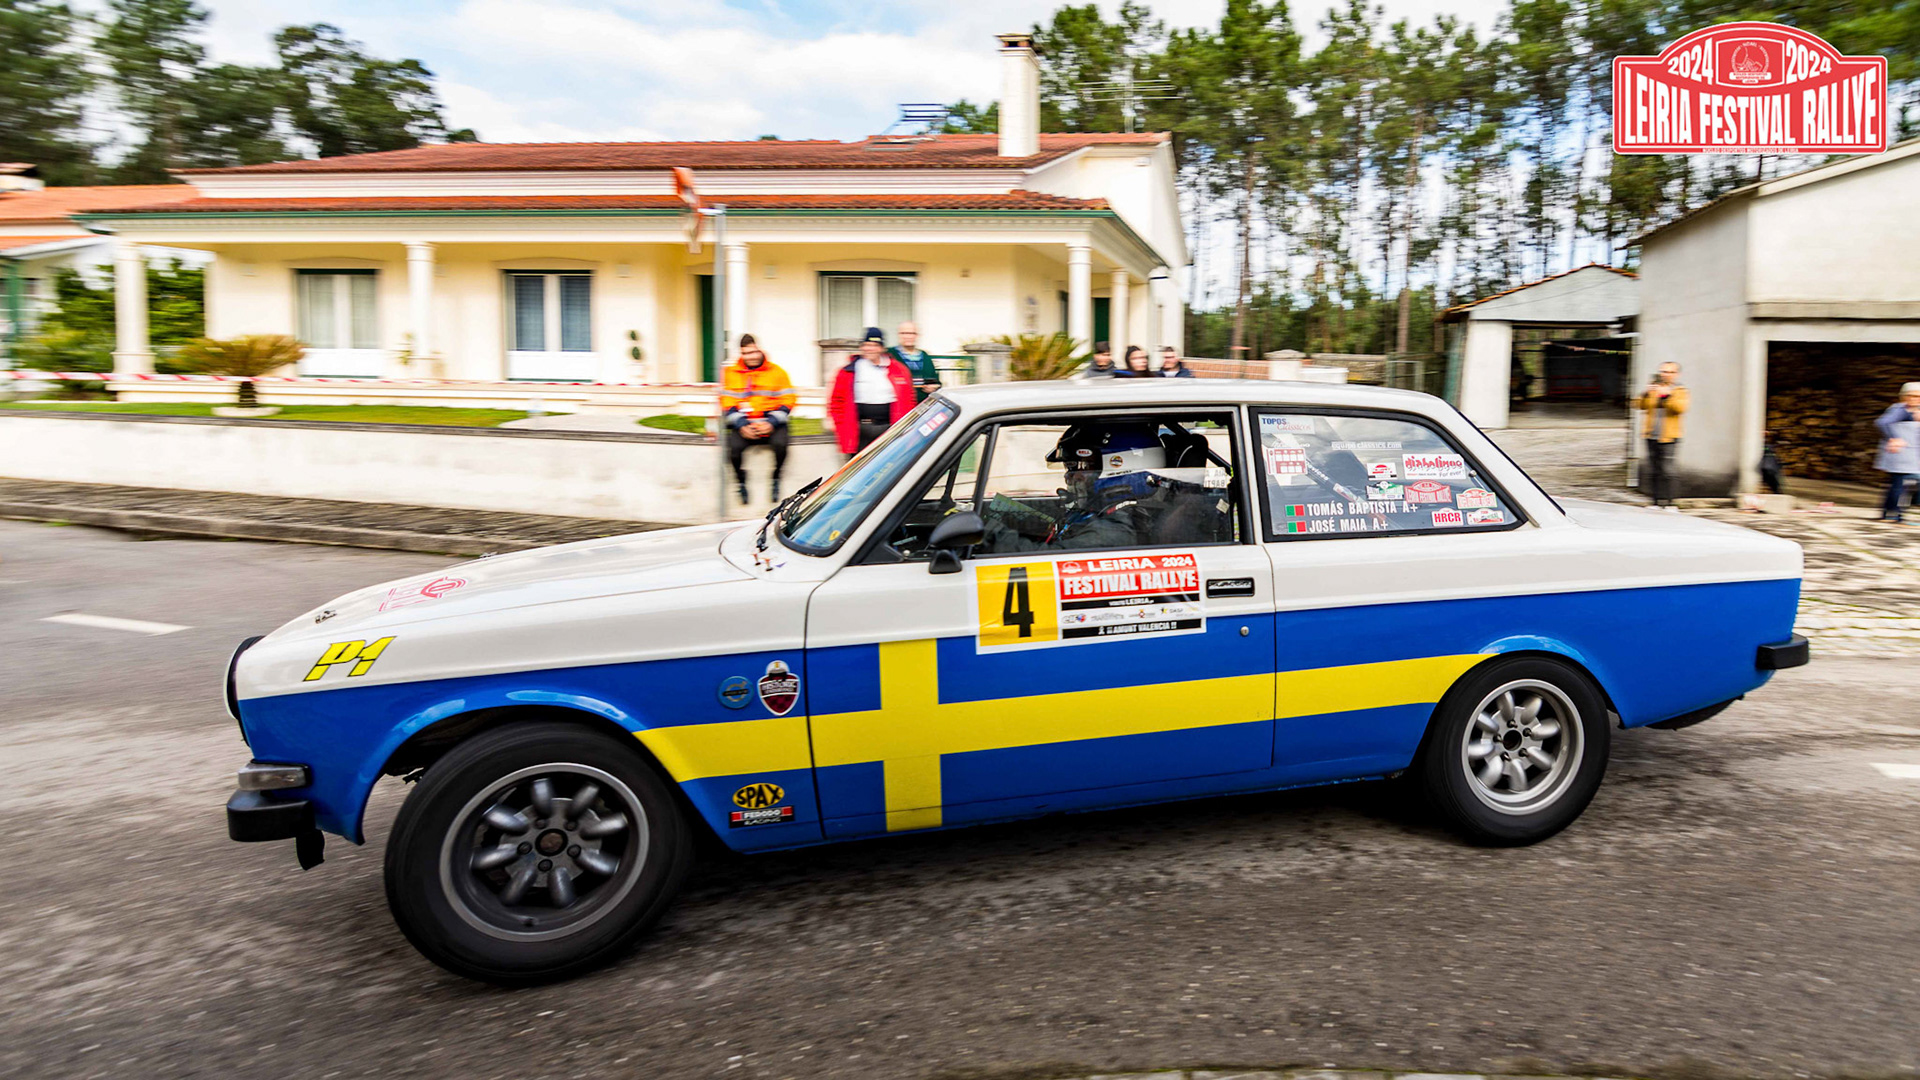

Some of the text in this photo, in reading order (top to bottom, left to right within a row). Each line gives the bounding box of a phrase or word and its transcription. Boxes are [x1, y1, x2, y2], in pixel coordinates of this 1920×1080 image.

[1261, 417, 1287, 425] TOPOS
[1307, 500, 1344, 517] TOMÁS
[1348, 501, 1397, 515] BAPTISTA
[1309, 517, 1335, 533] JOSÉ
[1340, 519, 1367, 531] MAIA
[1433, 512, 1462, 523] HRCR
[1087, 556, 1193, 572] LEIRIA 2024
[1063, 569, 1197, 596] FESTIVAL RALLYE
[1003, 566, 1035, 638] 4
[302, 636, 398, 682] P1
[736, 784, 781, 807] SPAX
[744, 809, 781, 818] FERODO
